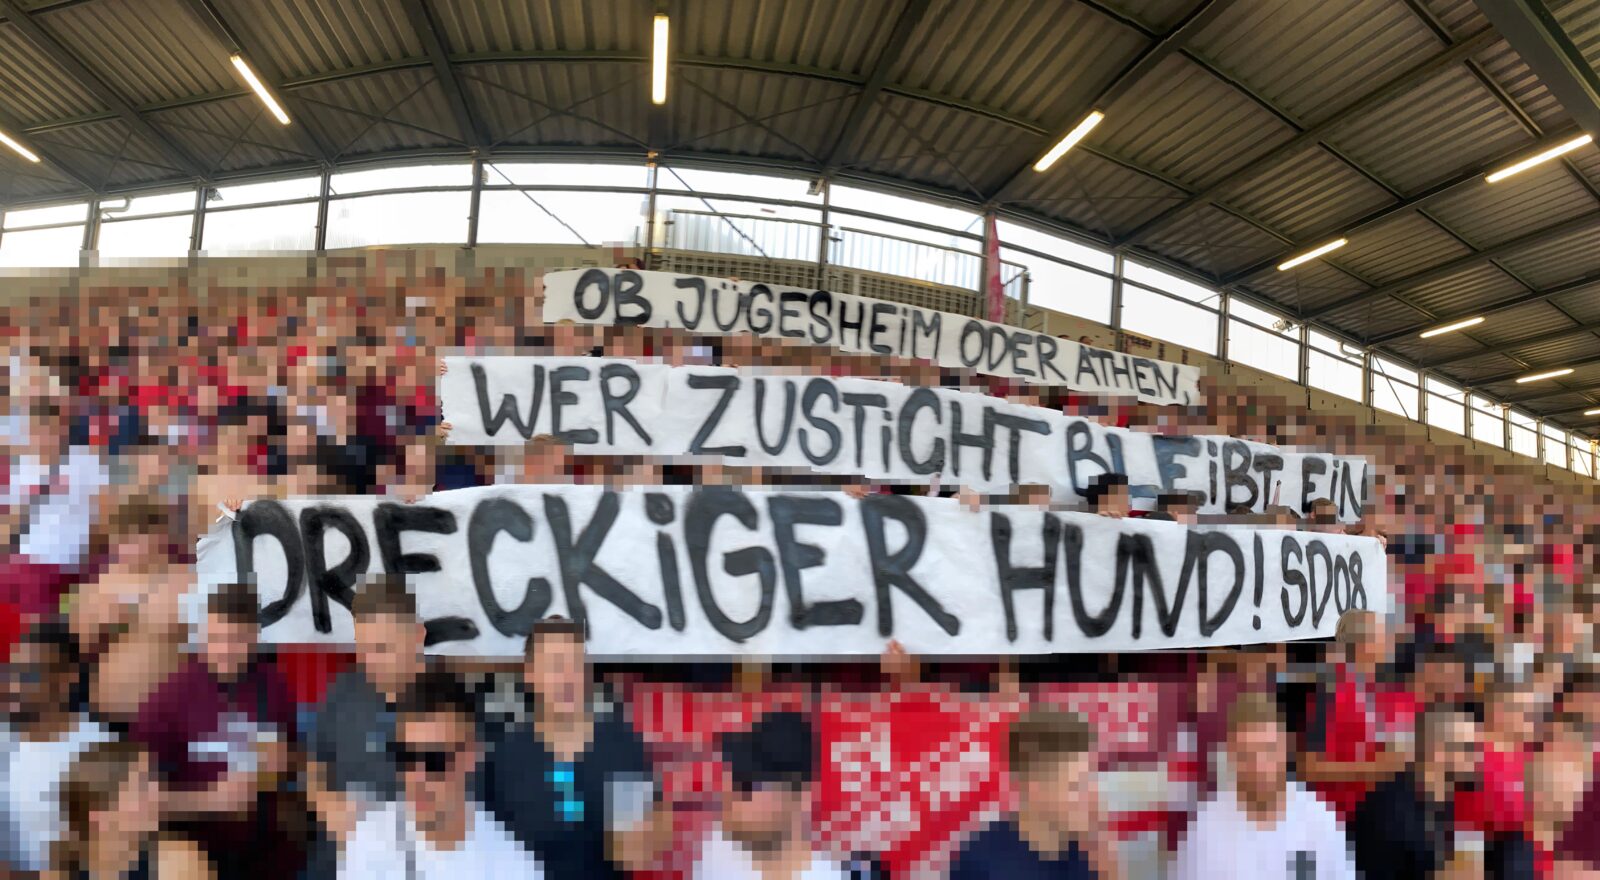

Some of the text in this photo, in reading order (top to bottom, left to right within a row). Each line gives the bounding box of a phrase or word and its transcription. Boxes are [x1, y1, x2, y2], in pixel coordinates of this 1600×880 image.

[574, 268, 652, 326] OB
[960, 319, 1067, 382] ODER
[1076, 345, 1191, 405] ATHEN,
[471, 363, 653, 446] WER
[990, 511, 1265, 643] HUND!
[1280, 535, 1368, 630] SD08
